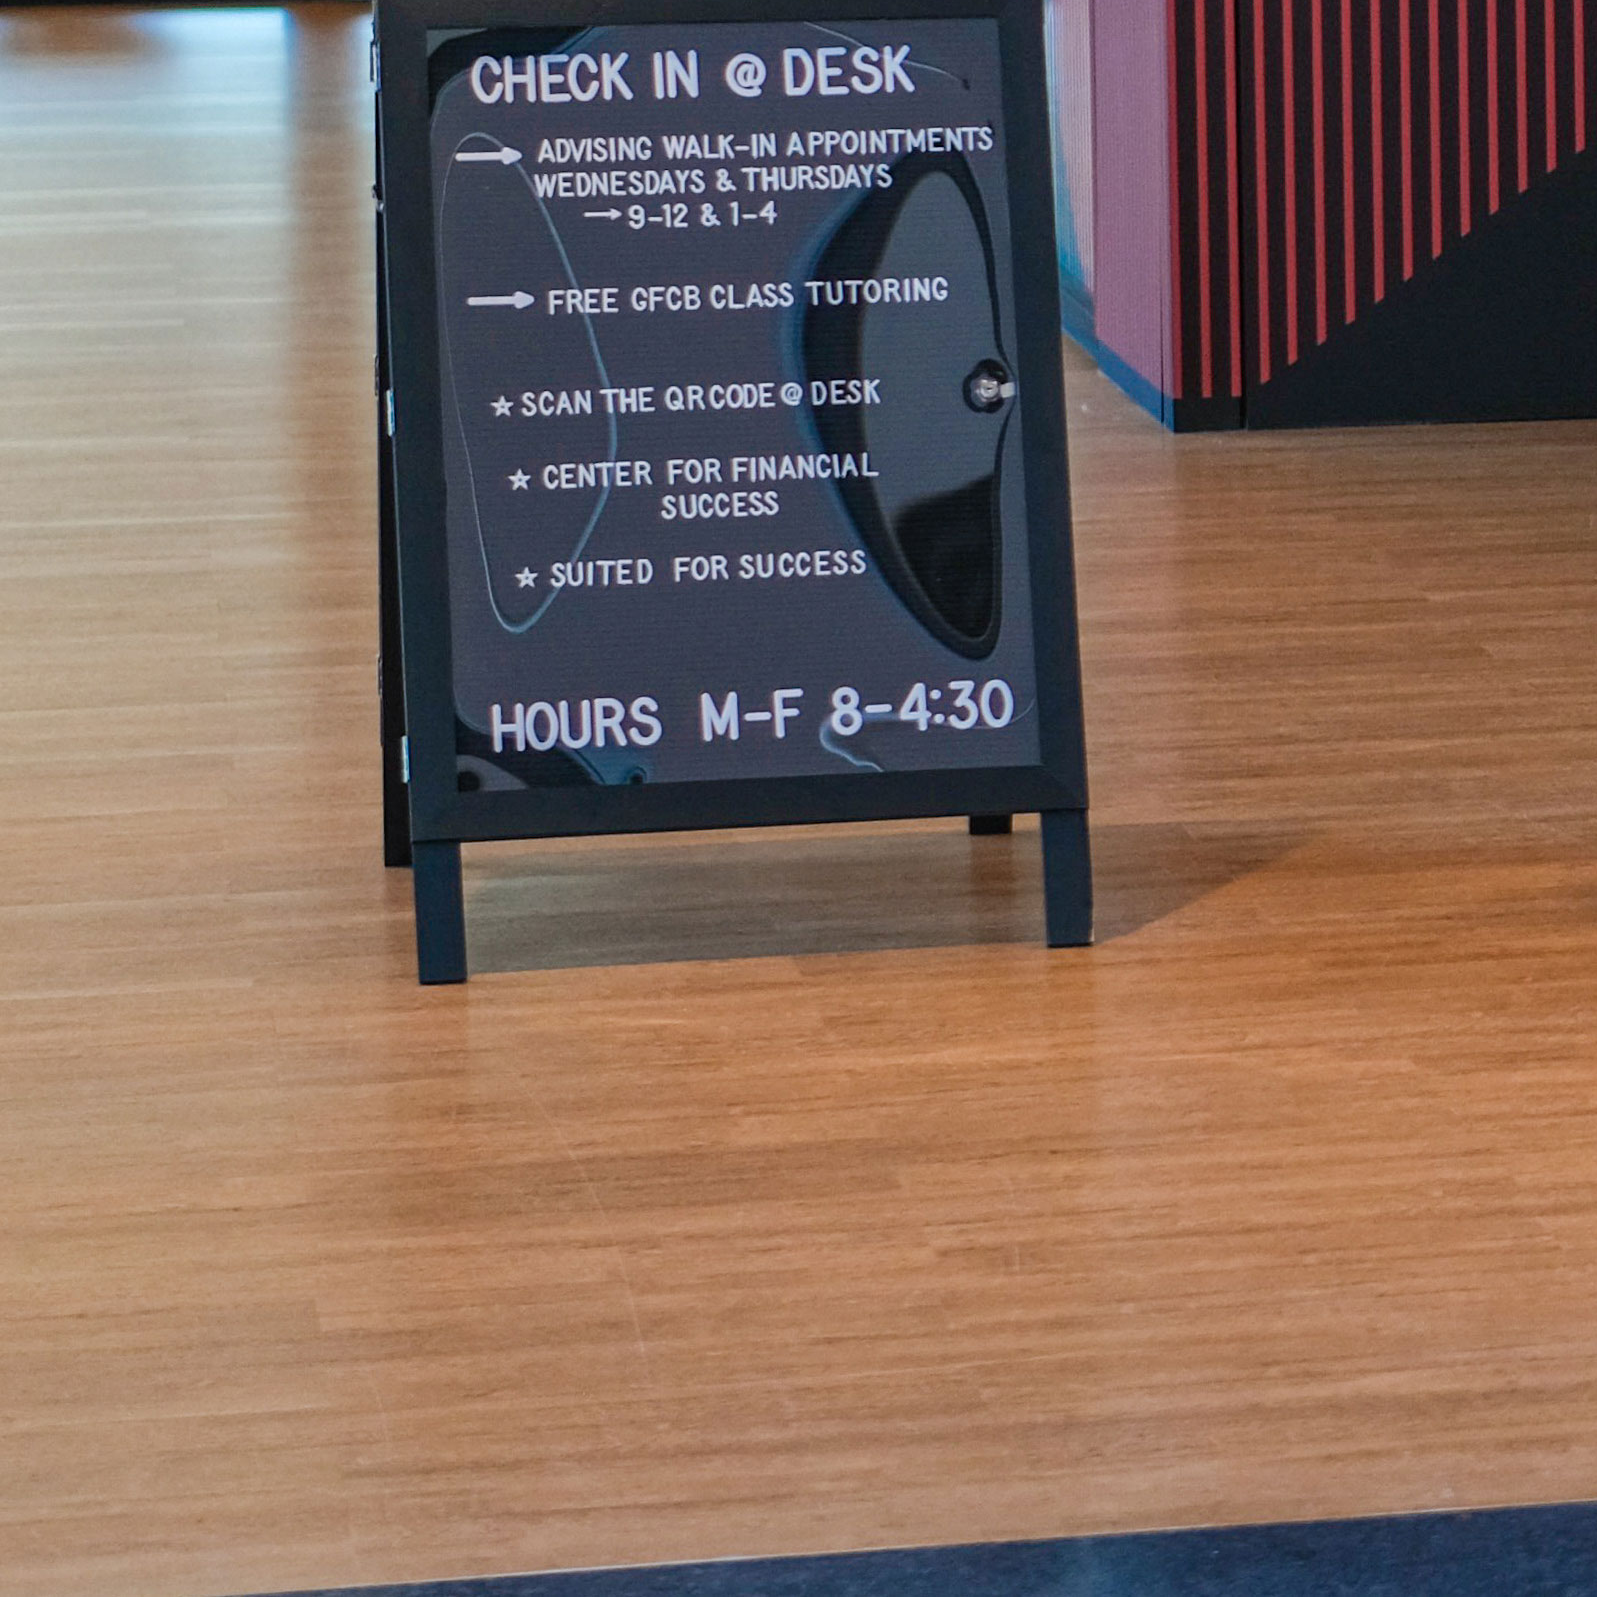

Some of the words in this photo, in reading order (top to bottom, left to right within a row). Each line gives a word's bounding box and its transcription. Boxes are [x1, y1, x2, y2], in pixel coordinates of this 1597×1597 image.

[470, 52, 633, 104] CHECK
[653, 50, 698, 99] IN
[725, 53, 766, 97] @
[783, 45, 915, 96] DESK
[537, 136, 652, 163] ADVISING
[662, 133, 776, 159] WALK-IN
[786, 126, 993, 156] APPOINTMENTS
[534, 169, 705, 198] WEDNESDAYS
[716, 168, 736, 192] &
[741, 164, 891, 192] THURSDAYS
[628, 203, 688, 230] 9-12
[700, 203, 720, 227] &
[730, 200, 777, 226] 1-4
[548, 288, 619, 315] FREE
[631, 285, 701, 312] GFCB
[709, 282, 794, 309] CLASS
[805, 276, 948, 305] TUTORING
[521, 390, 592, 417] SCAN
[599, 387, 655, 413] THE
[780, 382, 802, 406] @
[812, 379, 880, 405] DESK
[543, 460, 652, 490] CENTER
[667, 458, 722, 485] FOR
[732, 453, 879, 482] FINANCIAL
[661, 491, 779, 520] SUCCESS
[550, 558, 653, 588] SUITED
[674, 555, 729, 582] FOR
[739, 550, 866, 579] SUCCESS
[491, 696, 661, 752] HOURS
[700, 688, 803, 742] M-F
[830, 679, 1013, 735] 8-4:30
